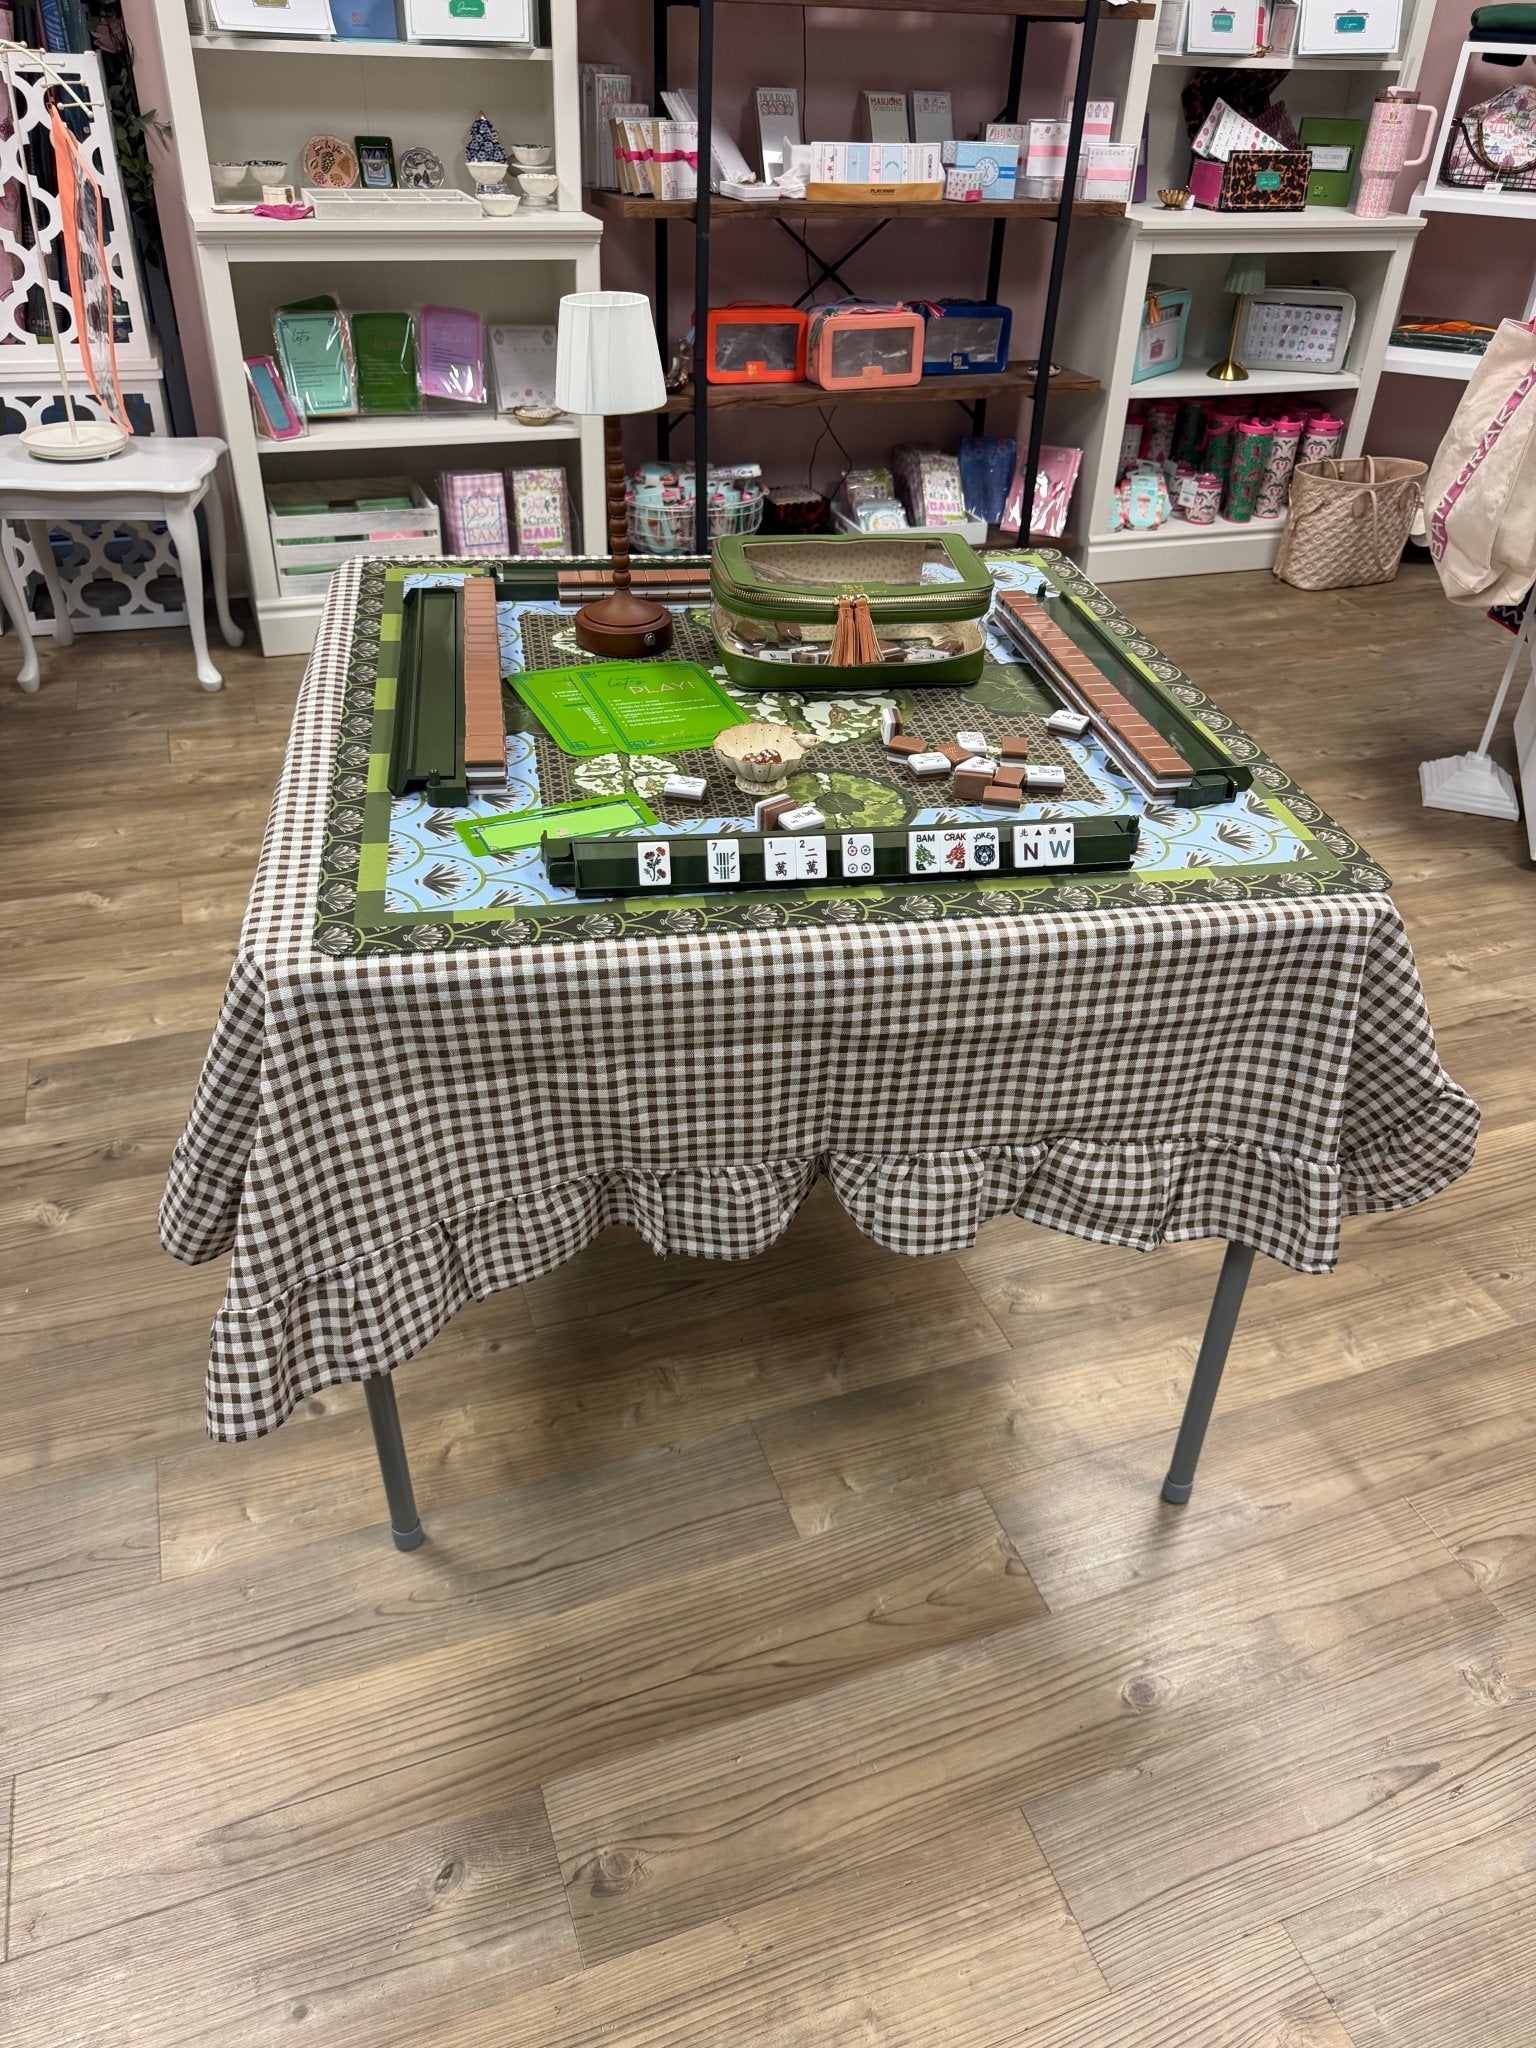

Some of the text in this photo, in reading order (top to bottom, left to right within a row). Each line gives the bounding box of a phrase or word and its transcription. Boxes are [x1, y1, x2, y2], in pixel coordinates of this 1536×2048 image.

[871, 97, 903, 107] MAHJONG
[1457, 404, 1513, 486] CRAK
[468, 527, 500, 543] BAM
[630, 681, 696, 695] PLAY!
[847, 837, 853, 845] 4
[916, 834, 935, 843] BAM
[944, 833, 966, 842] CRAK
[973, 832, 996, 843] JOKER
[712, 842, 718, 851] 7
[799, 840, 805, 849] 2
[1050, 840, 1071, 859] W
[1023, 842, 1039, 861] N
